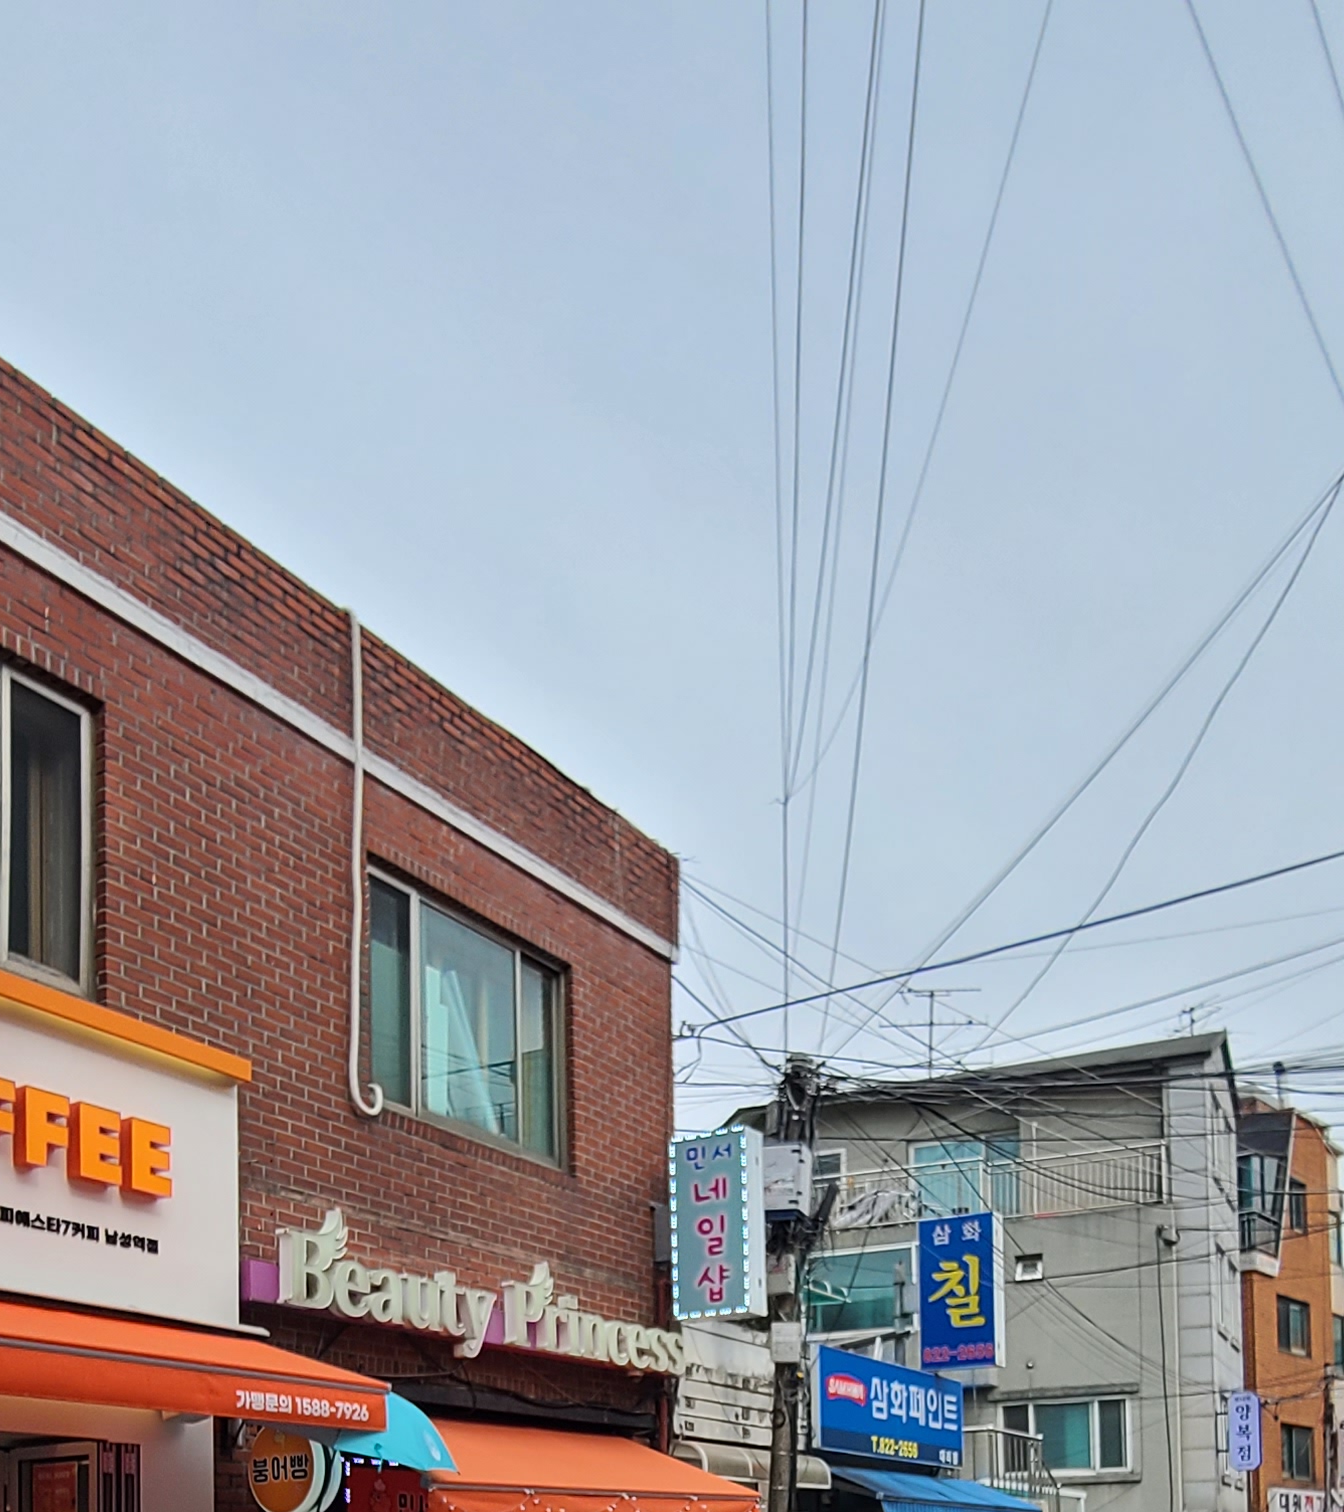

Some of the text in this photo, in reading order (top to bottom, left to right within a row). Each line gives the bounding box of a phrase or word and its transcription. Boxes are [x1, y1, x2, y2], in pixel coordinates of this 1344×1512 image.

[686, 1143, 733, 1170] 민서
[104, 1227, 160, 1257] 남성역점
[932, 1220, 982, 1246] 삼화
[276, 1207, 686, 1376] Beauty Princess
[928, 1253, 986, 1329] 칠
[235, 1389, 369, 1422] 가맹문의 1588-7926
[870, 1376, 959, 1432] 삼화페인트
[1235, 1403, 1252, 1462] 양복점
[251, 1452, 311, 1484] 붕어빵
